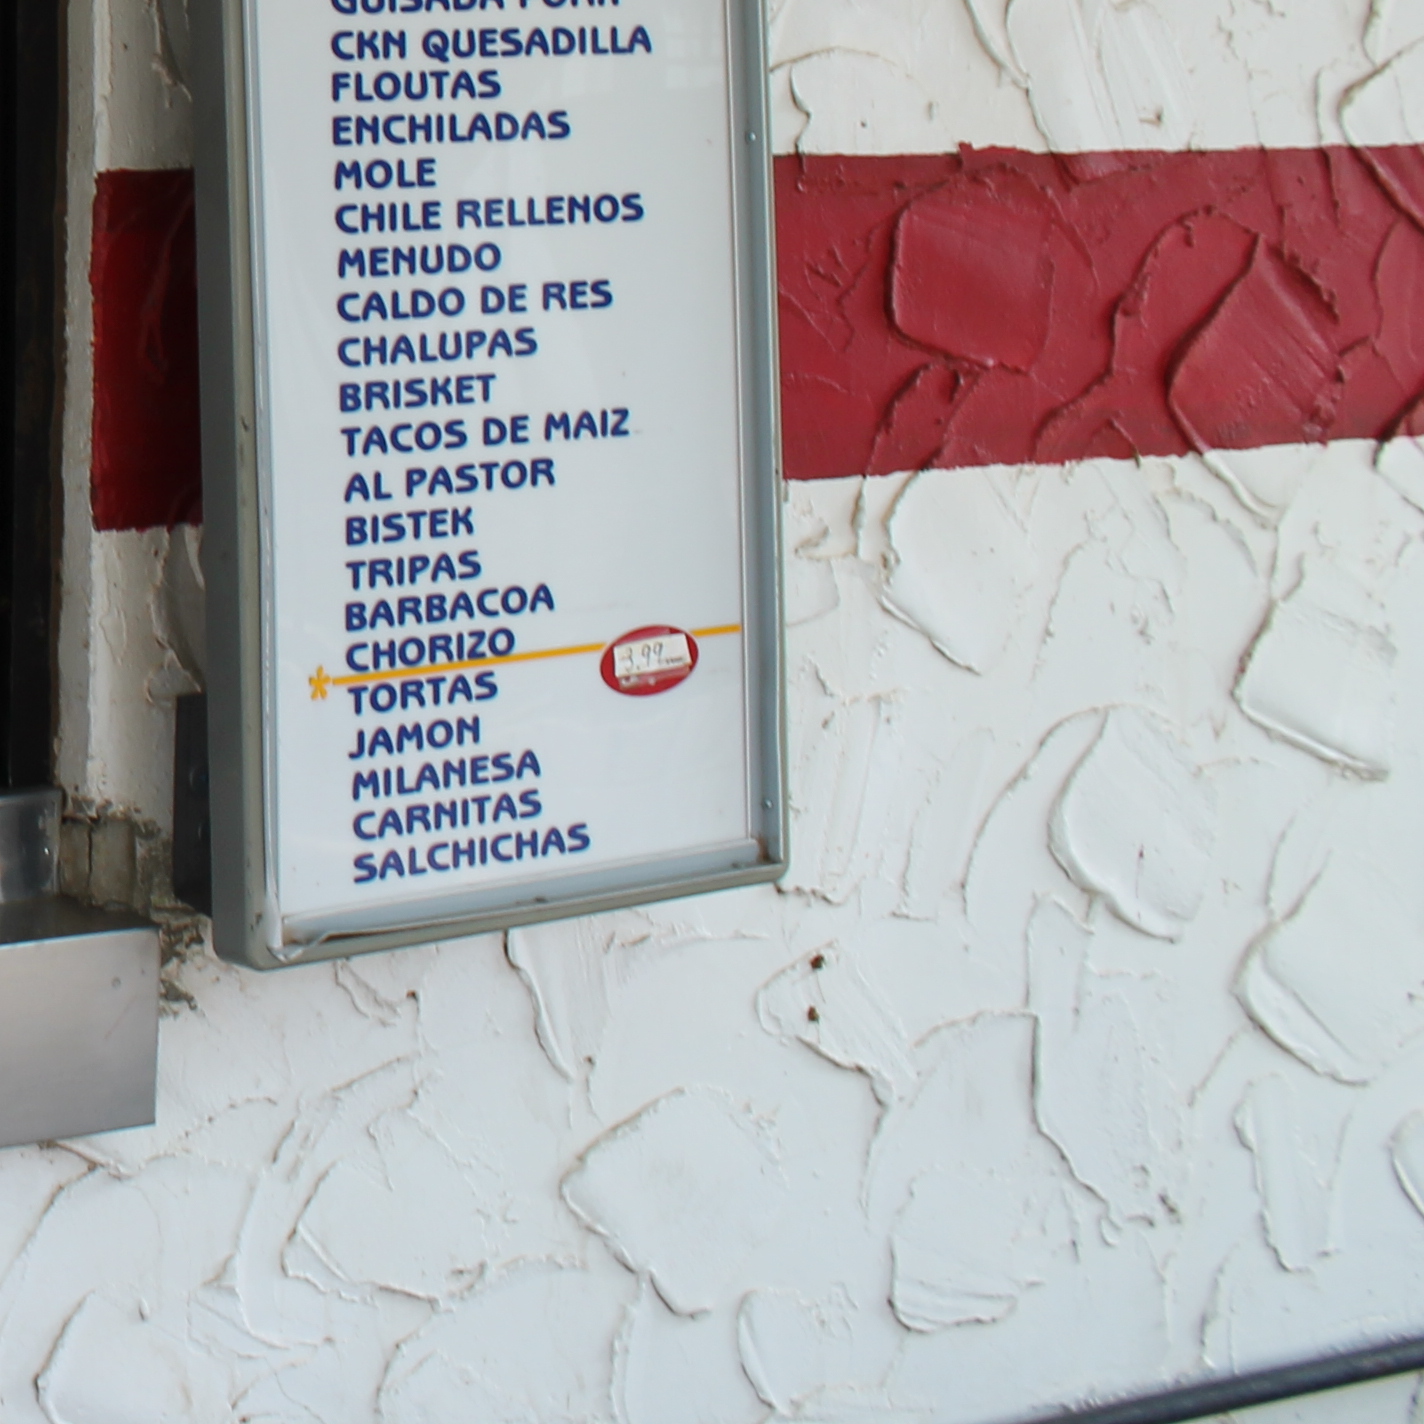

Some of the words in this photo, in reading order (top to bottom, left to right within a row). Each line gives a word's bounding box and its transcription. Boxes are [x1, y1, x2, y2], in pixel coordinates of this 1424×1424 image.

[333, 29, 408, 62] CKN
[424, 25, 653, 64] QUESADILLA
[334, 68, 503, 103] FLOUTAS
[334, 110, 572, 148] ENCHILADAS
[337, 200, 443, 236] CHILE
[458, 192, 646, 230] RELLENOS
[339, 242, 503, 280] MENUDO
[338, 286, 467, 324] CALDO
[482, 283, 528, 316] DE
[544, 279, 614, 312] RES
[339, 326, 539, 369] CHALUPAS
[342, 419, 469, 458] TACOS
[484, 414, 531, 448] DE
[546, 407, 631, 443] MAIZ
[345, 471, 394, 504] AL
[407, 457, 556, 499] PASTOR
[347, 507, 475, 548] BISTEK
[347, 628, 516, 673] CHORIZO
[347, 671, 499, 717] TORTAS
[352, 750, 542, 800] MILANESA
[354, 824, 592, 884] SALCHICHAS
